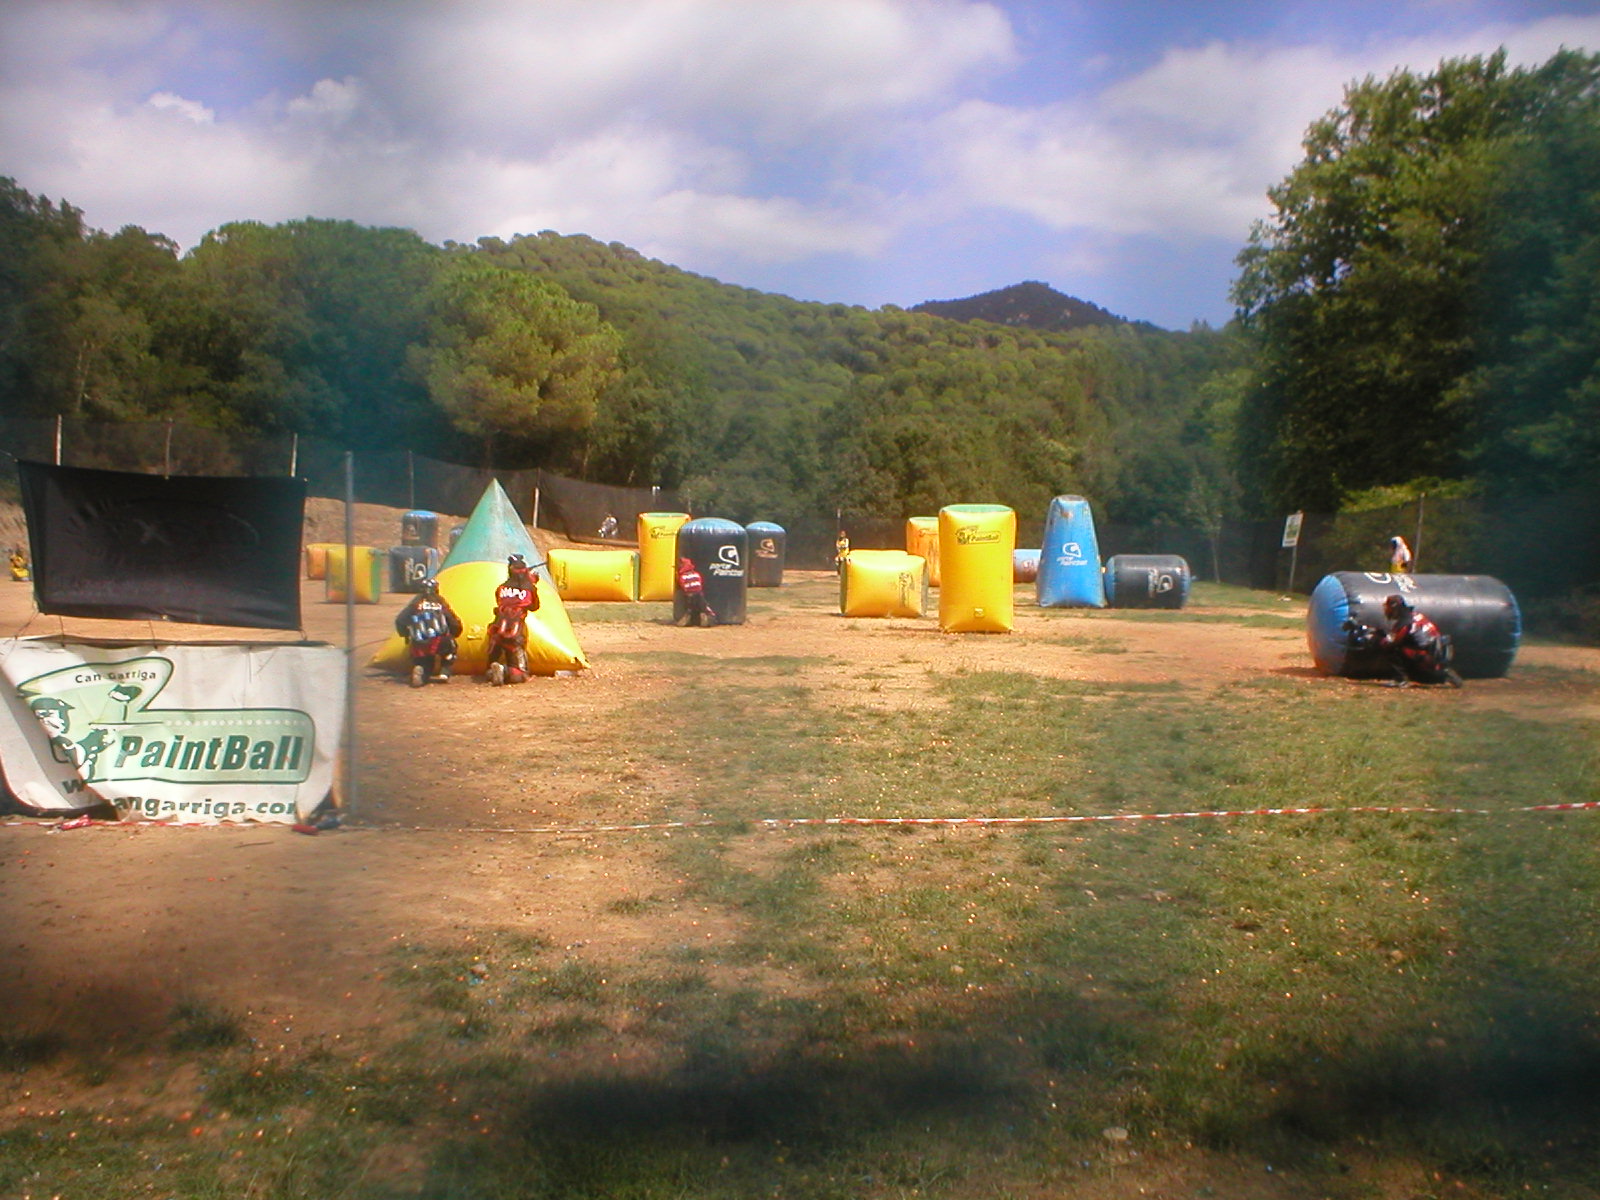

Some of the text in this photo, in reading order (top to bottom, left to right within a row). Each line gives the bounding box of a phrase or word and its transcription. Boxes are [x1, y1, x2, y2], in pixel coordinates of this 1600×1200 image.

[75, 669, 156, 683] Can Garriga
[113, 735, 304, 770] PaintBall
